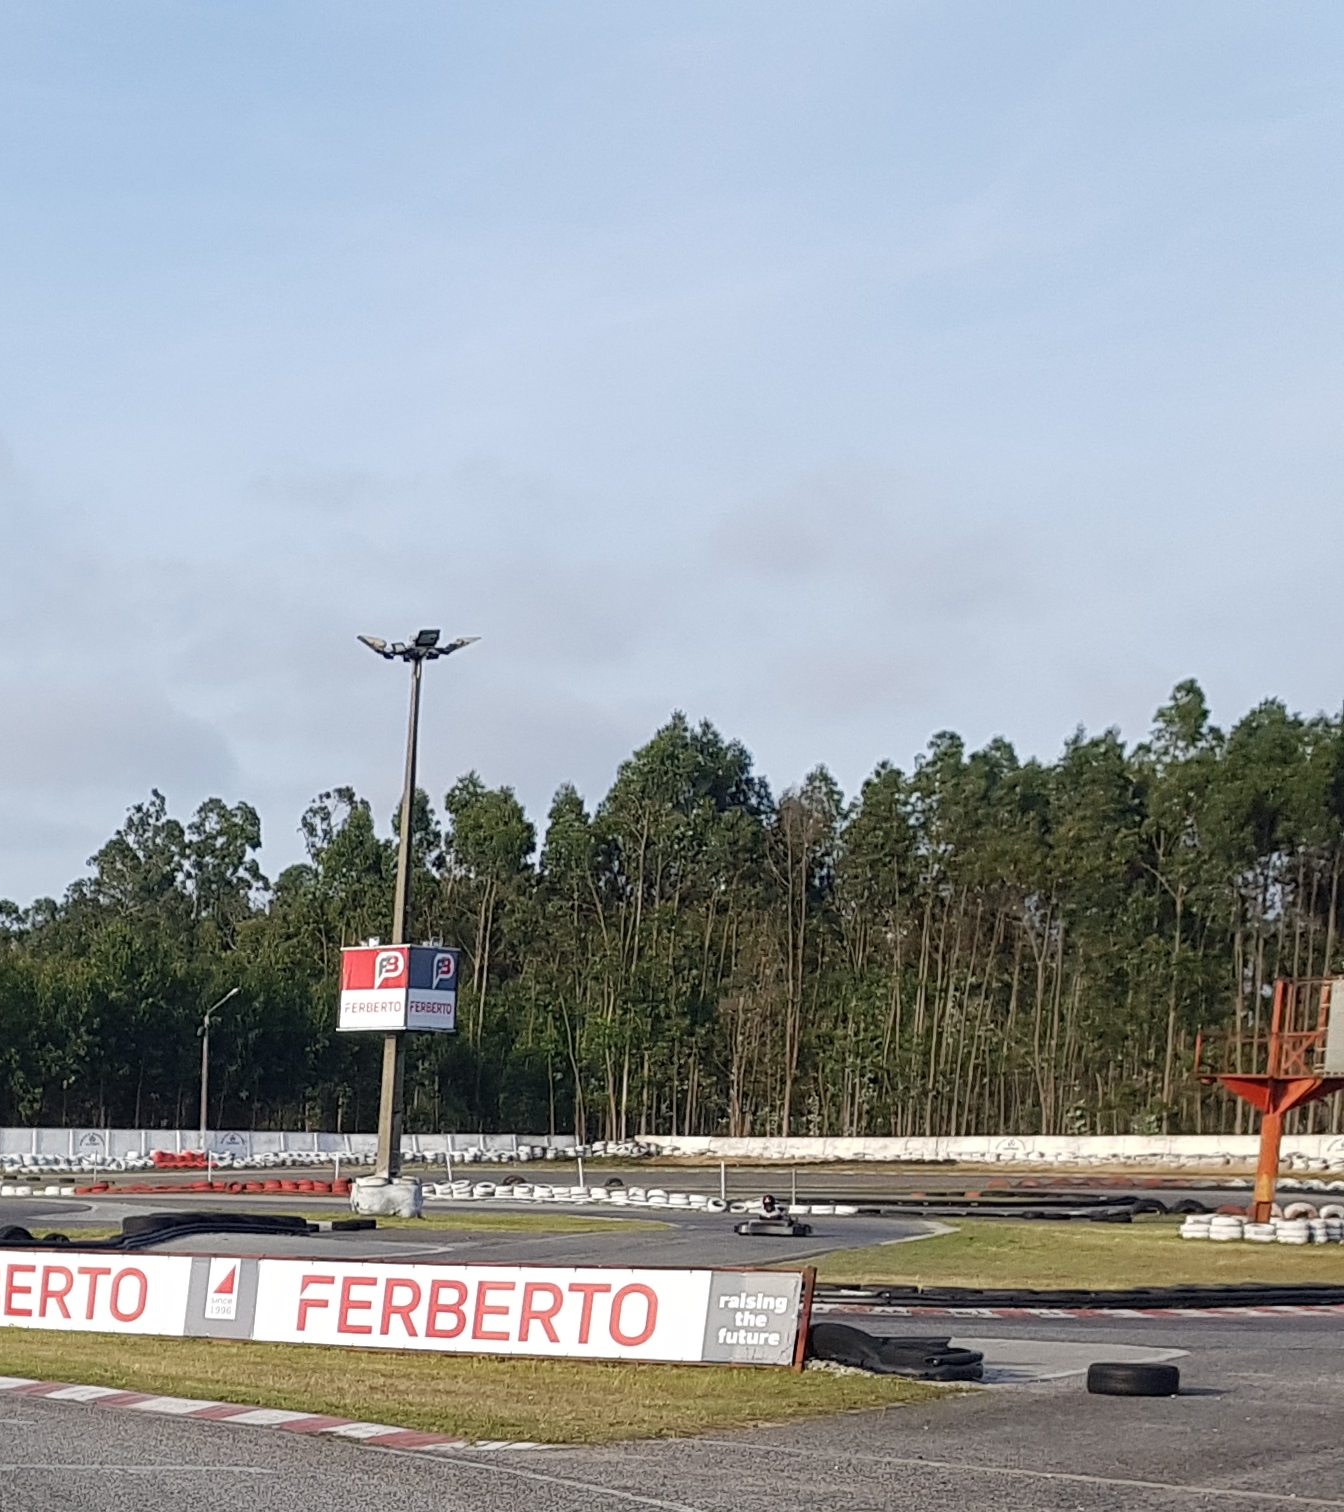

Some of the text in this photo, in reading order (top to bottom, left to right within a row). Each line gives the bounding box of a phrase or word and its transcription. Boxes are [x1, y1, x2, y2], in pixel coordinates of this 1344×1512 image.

[344, 1001, 402, 1014] FERBERTO
[410, 1001, 453, 1015] FERBERTO
[211, 1297, 233, 1305] since
[719, 1292, 788, 1314] raising
[211, 1306, 232, 1315] 1996
[296, 1274, 659, 1347] FERBERTO
[735, 1311, 768, 1327] the
[718, 1327, 780, 1346] future
